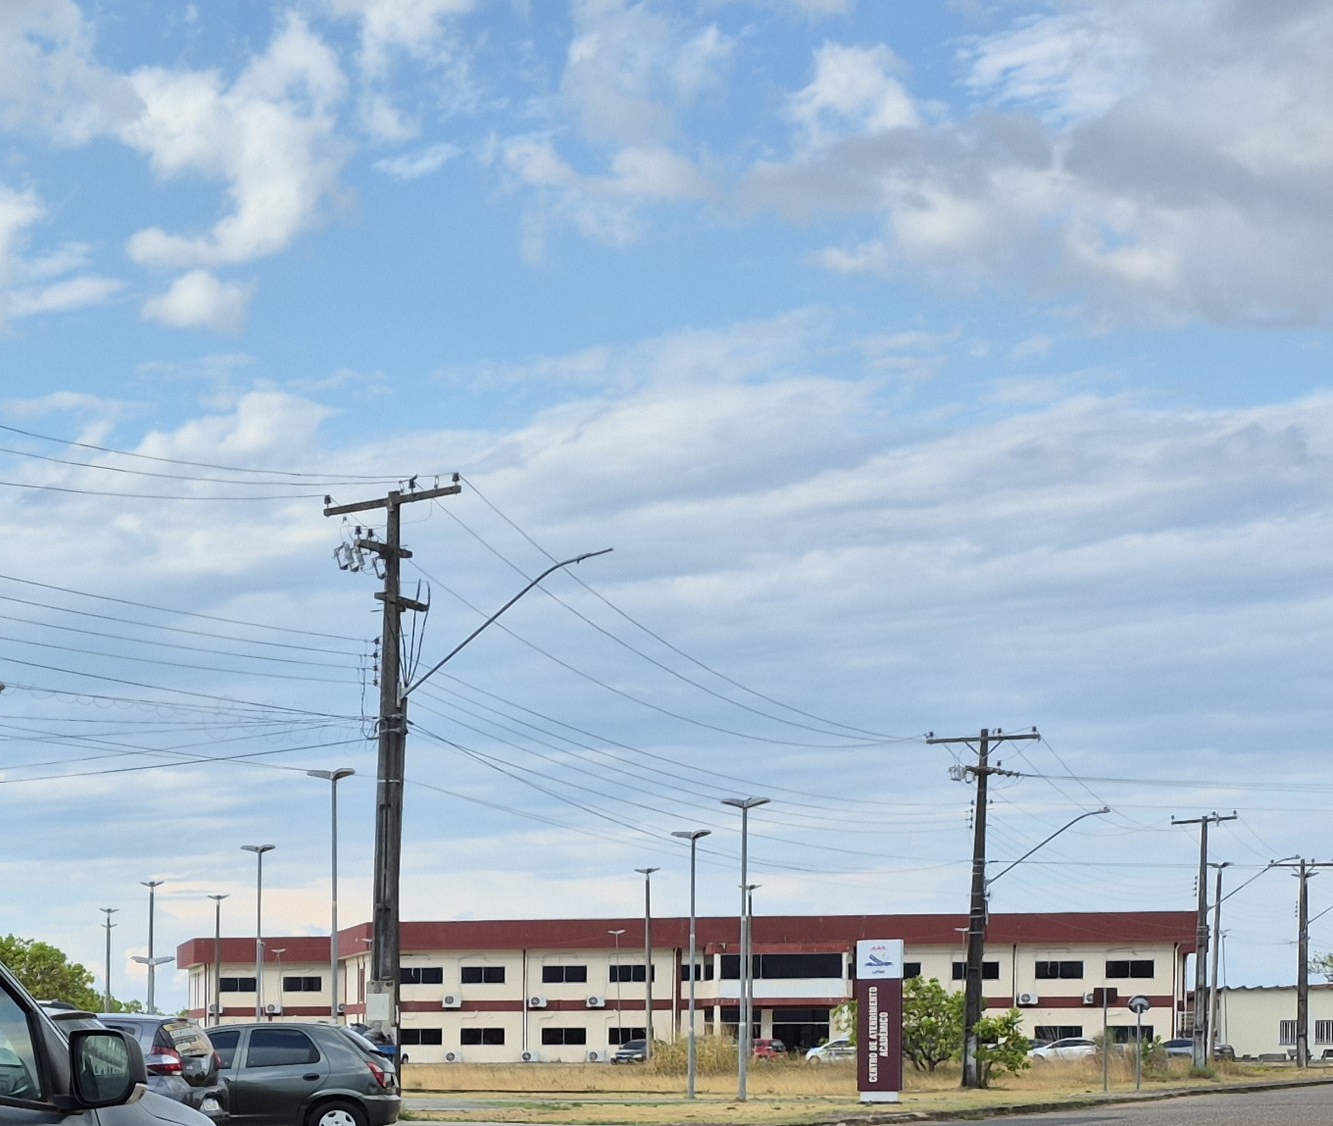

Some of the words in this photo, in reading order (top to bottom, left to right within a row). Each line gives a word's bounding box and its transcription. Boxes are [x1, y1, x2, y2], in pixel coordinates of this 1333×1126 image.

[869, 987, 878, 1040] ATENDIMENTO
[869, 1041, 878, 1051] DE
[869, 1052, 878, 1082] CENTRO
